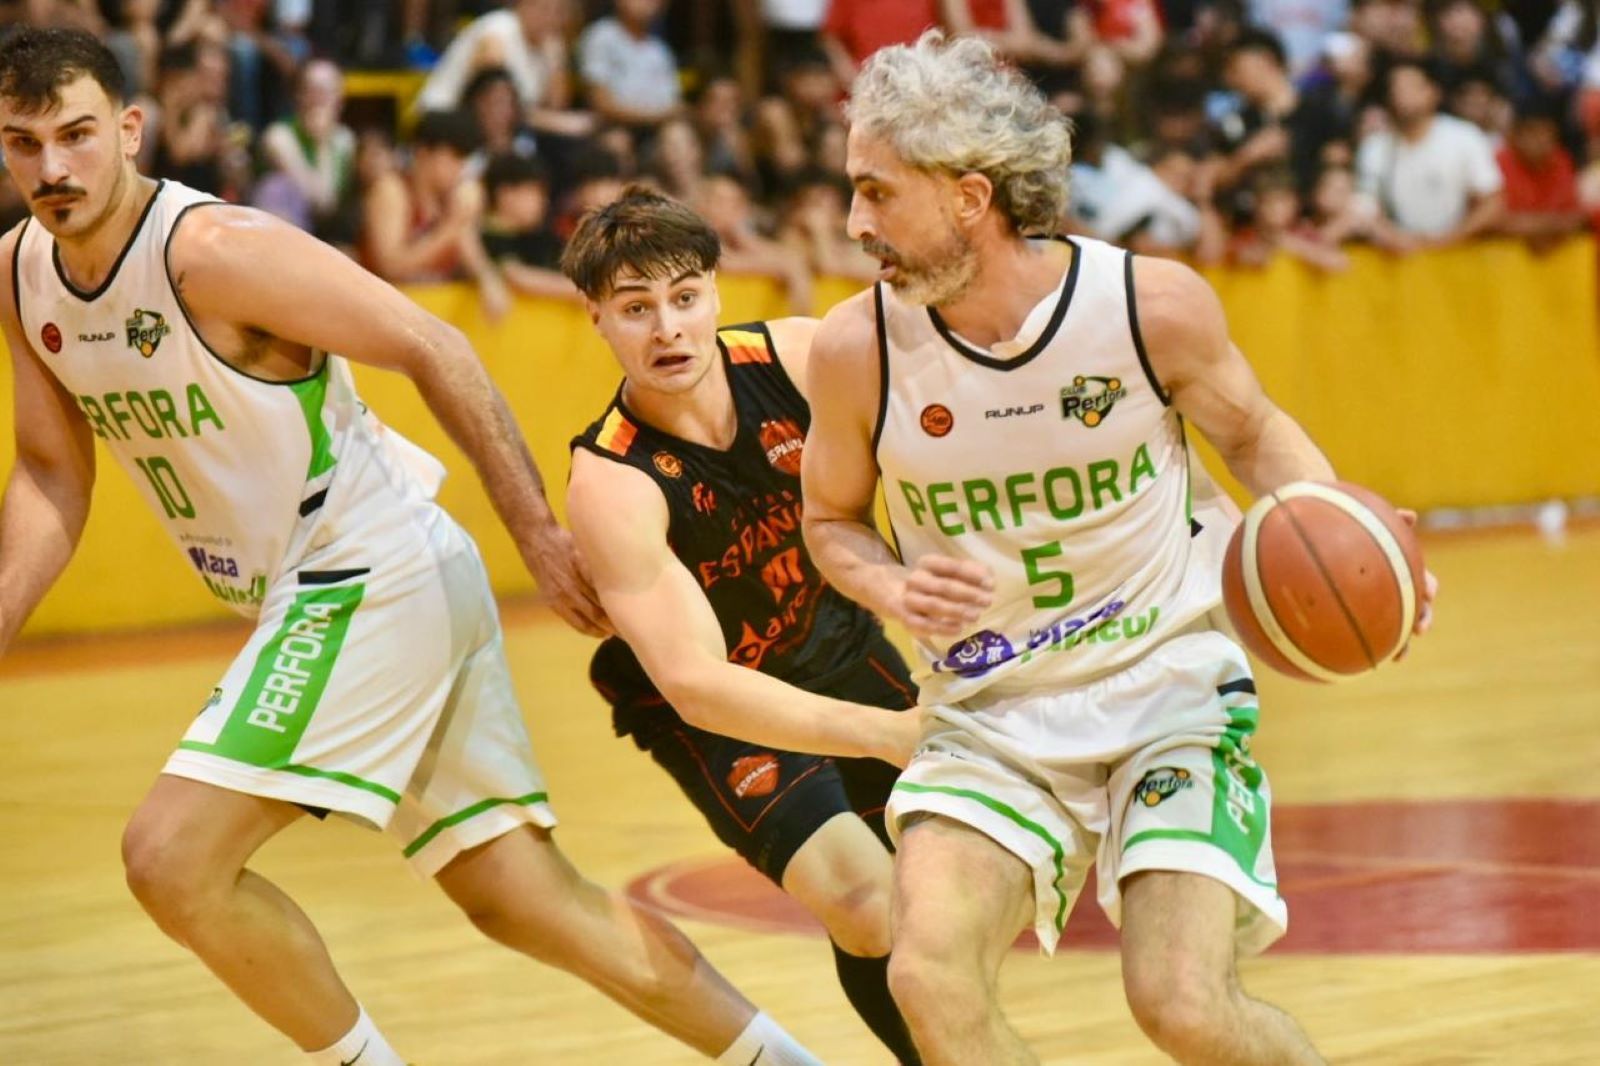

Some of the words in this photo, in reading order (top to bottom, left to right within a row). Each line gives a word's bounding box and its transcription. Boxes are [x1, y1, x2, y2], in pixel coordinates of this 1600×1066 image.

[985, 403, 1045, 419] RUNUP
[1062, 387, 1127, 418] Perfora
[134, 456, 196, 519] 10
[898, 443, 1157, 536] PERFORA
[1020, 541, 1075, 609] 5
[247, 602, 342, 734] PERFORA
